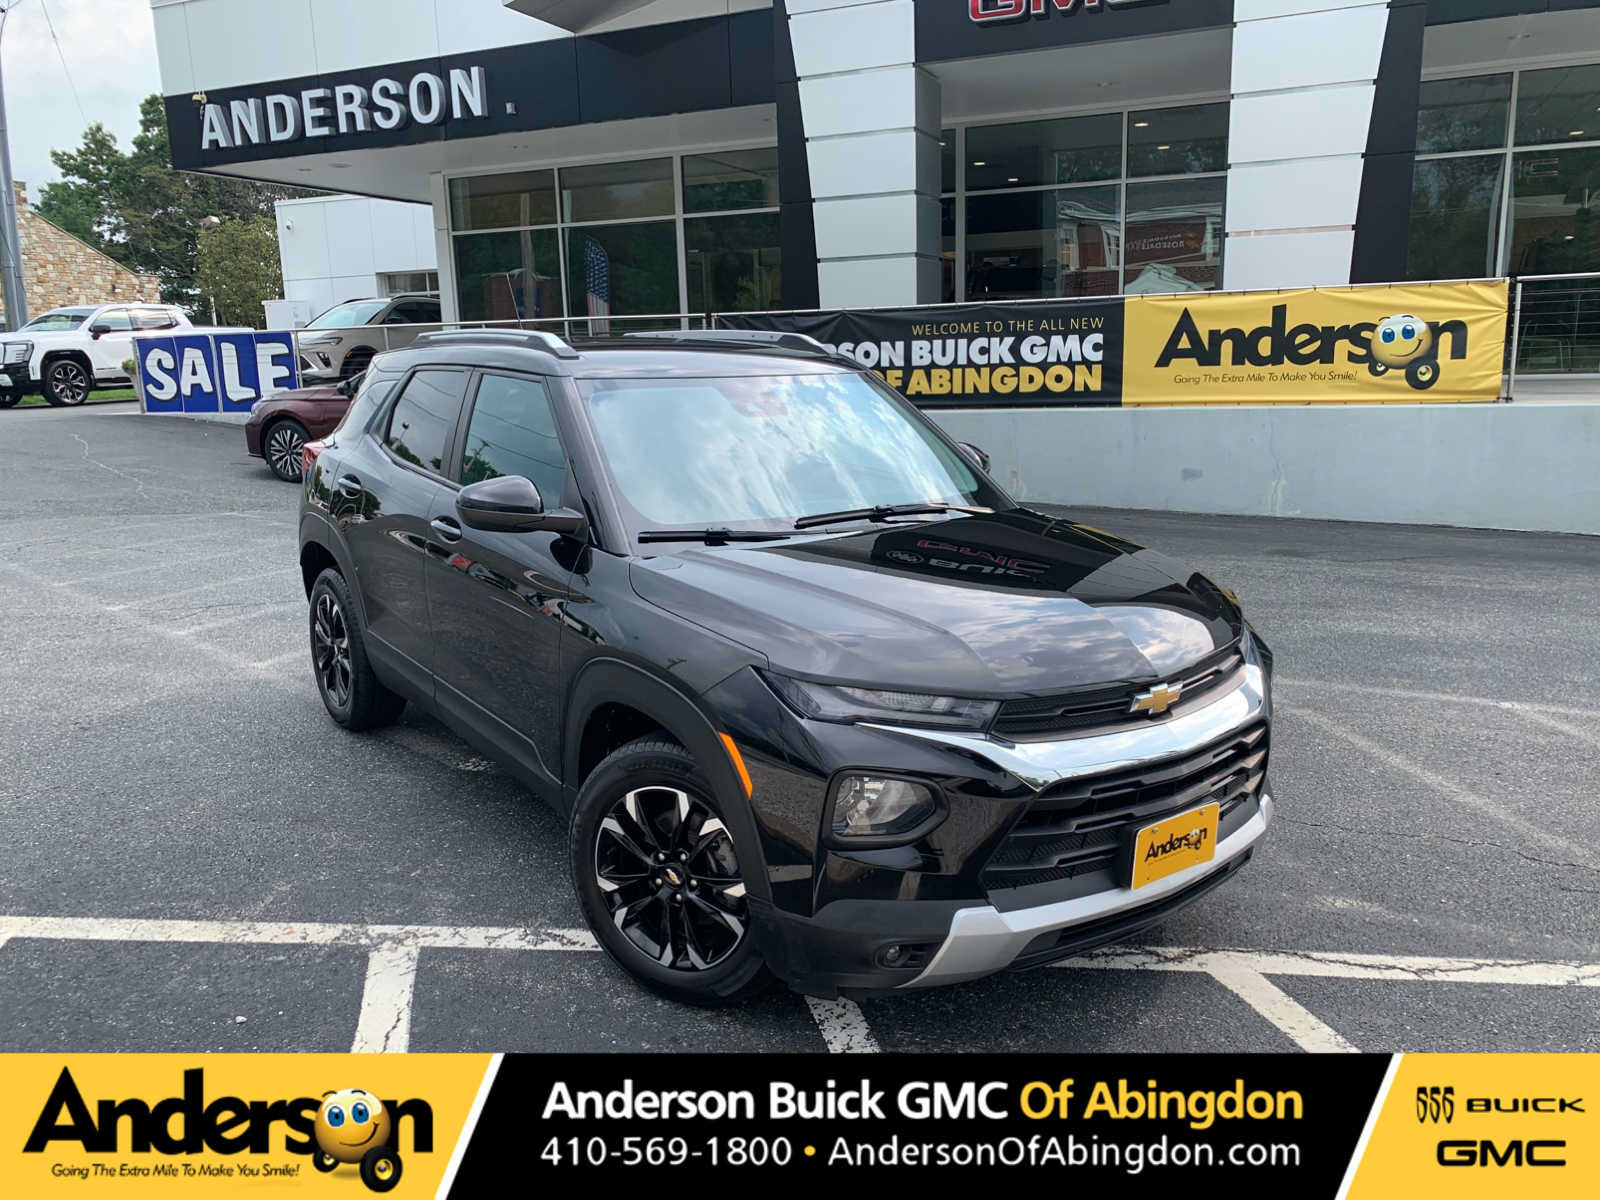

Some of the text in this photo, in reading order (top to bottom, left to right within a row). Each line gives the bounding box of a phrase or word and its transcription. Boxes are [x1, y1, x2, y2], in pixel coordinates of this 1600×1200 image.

[201, 66, 489, 150] ANDERSON
[911, 317, 1104, 336] WELCOME TO THE ALL NEW
[822, 333, 1104, 368] SON BUICK GMC
[145, 342, 290, 402] SALE
[871, 364, 1102, 395] F ABINGDON
[1174, 371, 1358, 385] Going The Extra Mile To Make You Smile!
